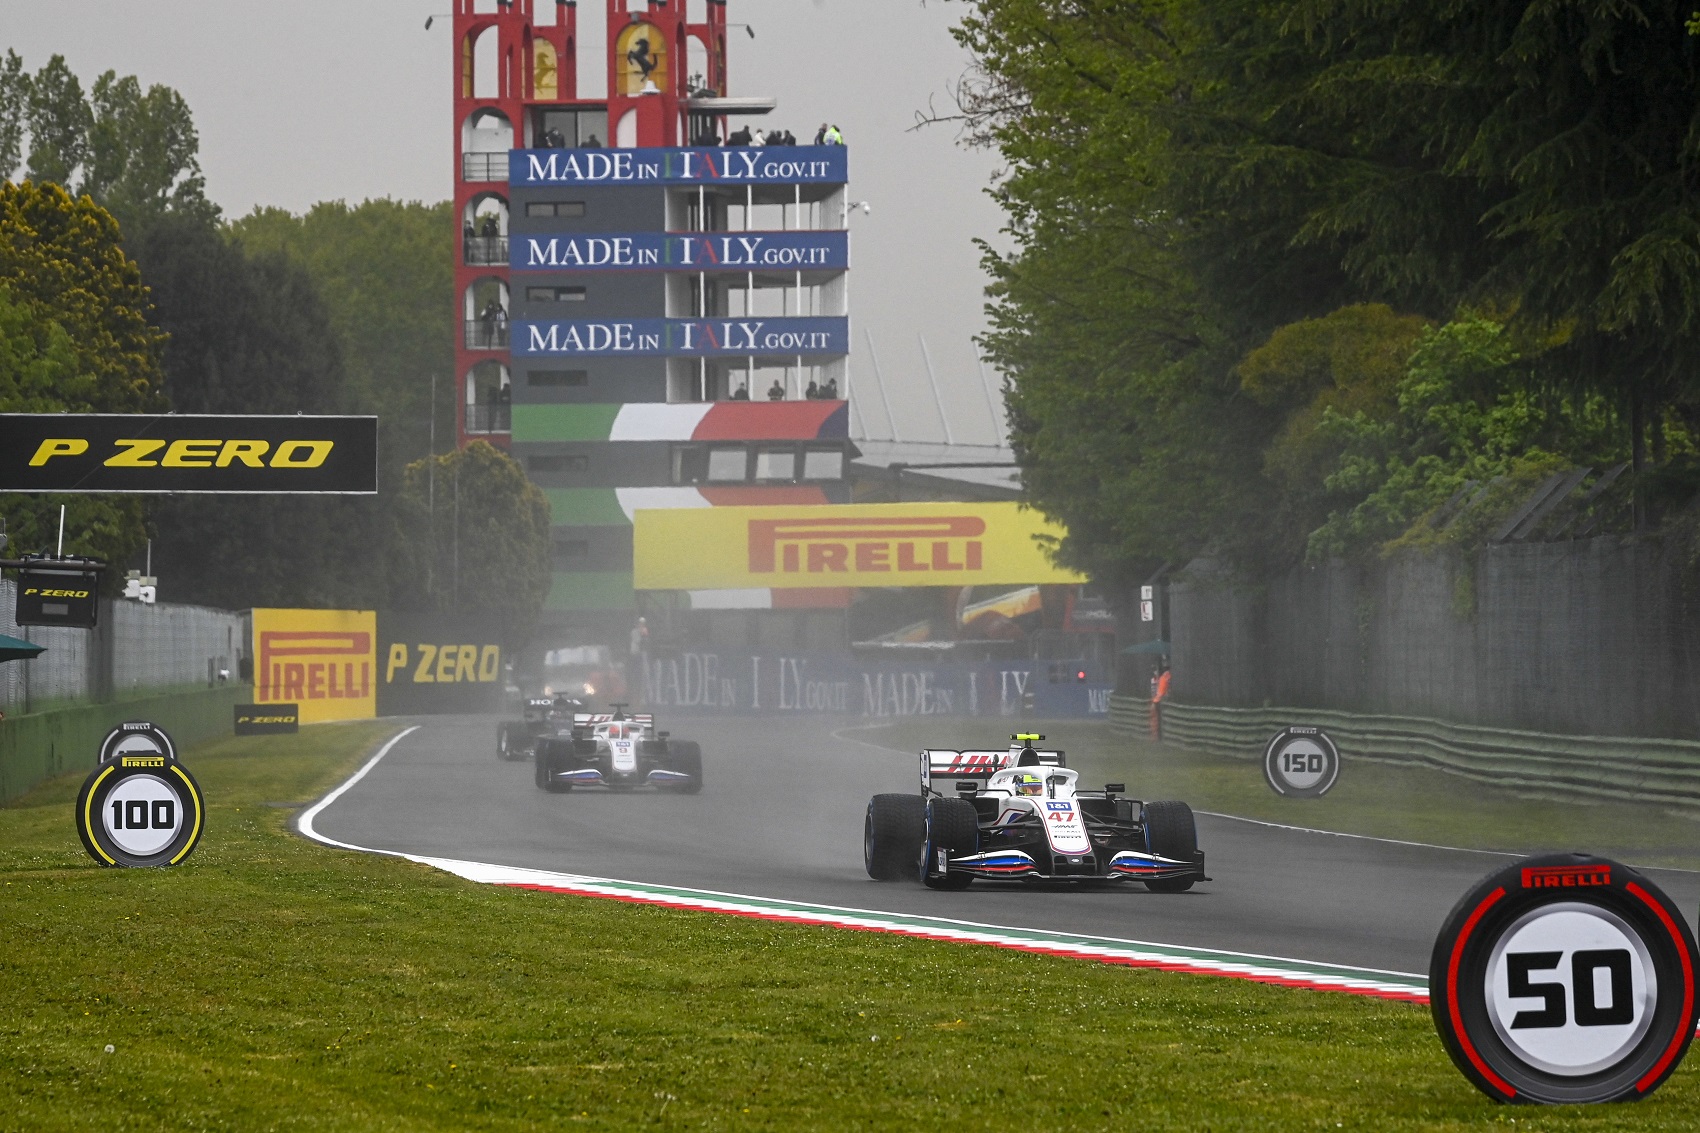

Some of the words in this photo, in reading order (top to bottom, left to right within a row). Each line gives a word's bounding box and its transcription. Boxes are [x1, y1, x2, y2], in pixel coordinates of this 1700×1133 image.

[526, 152, 633, 181] MADE
[637, 162, 658, 179] IN
[527, 237, 633, 265] MADE
[638, 248, 658, 264] IN
[527, 323, 633, 351] MADE
[638, 333, 659, 350] IN
[28, 438, 89, 466] P
[103, 438, 334, 468] ZERO
[748, 516, 986, 573] PIRELLI
[40, 589, 89, 598] ZERO
[259, 631, 371, 702] PIRELLI
[387, 643, 407, 683] P
[414, 644, 499, 682] ZERO
[862, 671, 934, 717] MADE
[123, 722, 151, 730] PIRELLI
[251, 716, 296, 724] ZERO
[122, 757, 165, 767] PIRELLI
[1283, 753, 1323, 773] 150
[111, 800, 175, 830] 100
[1048, 812, 1075, 822] 47
[1521, 865, 1611, 888] PIRELLI
[1506, 948, 1634, 1029] 50
